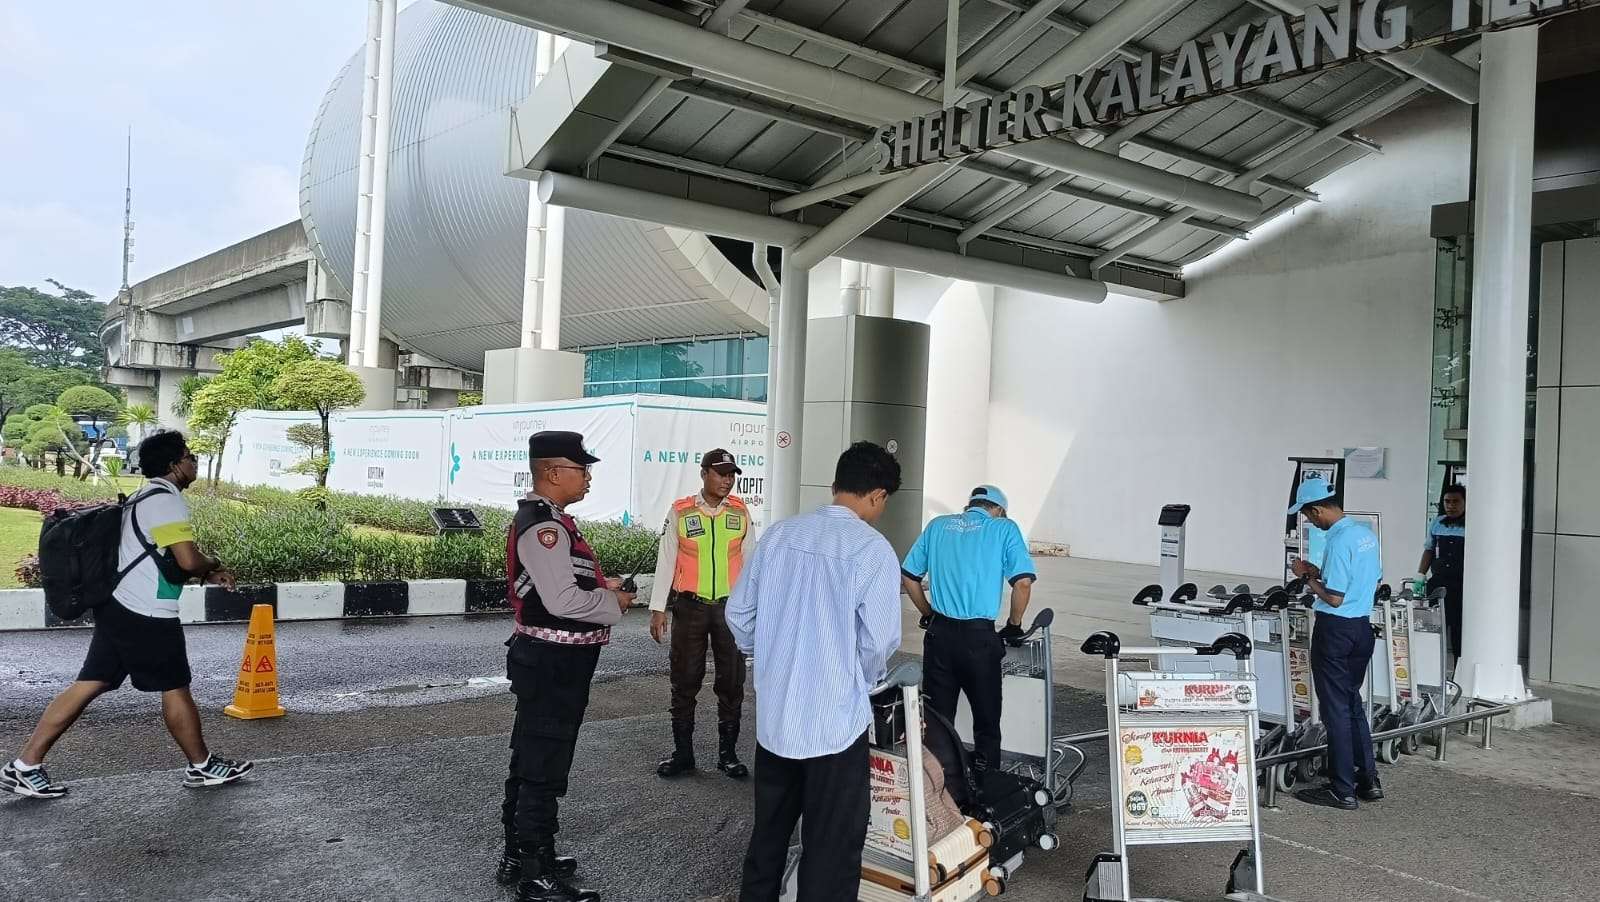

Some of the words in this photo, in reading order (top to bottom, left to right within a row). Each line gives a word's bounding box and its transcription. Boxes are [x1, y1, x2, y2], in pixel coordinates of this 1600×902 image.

[871, 84, 1046, 175] SHELTER
[1062, 0, 1407, 127] KALAYANG
[478, 450, 492, 460] NEW
[643, 450, 652, 462] A
[658, 450, 689, 463] NEW
[1152, 731, 1209, 746] KURNIA
